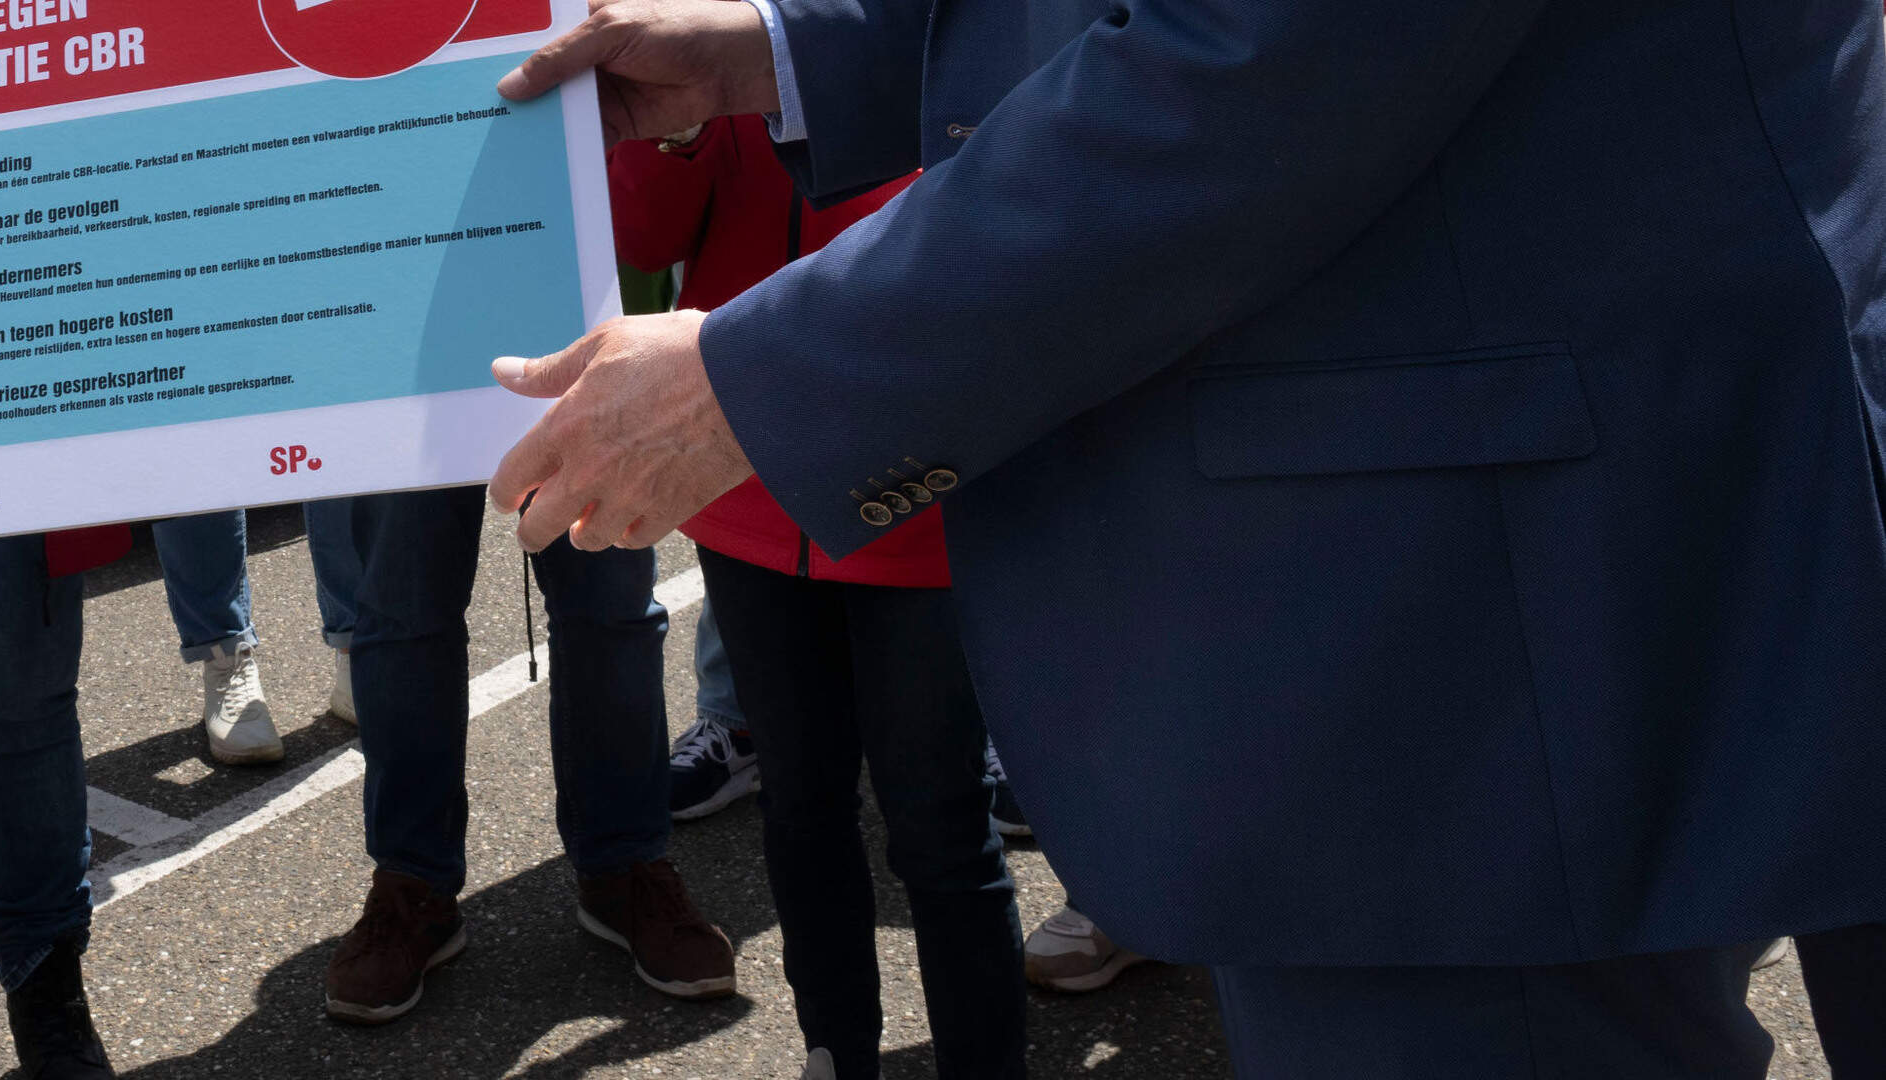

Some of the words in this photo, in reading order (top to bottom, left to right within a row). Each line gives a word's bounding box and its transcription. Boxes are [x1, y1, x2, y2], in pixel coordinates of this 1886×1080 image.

[63, 26, 146, 76] CBR
[10, 175, 29, 188] één
[30, 169, 71, 185] centrale
[72, 160, 133, 179] CBR-locatie.
[134, 151, 179, 169] Parkstad
[180, 151, 194, 163] en
[195, 141, 250, 160] Maastricht
[250, 137, 290, 152] moeten
[290, 134, 311, 146] een
[311, 124, 376, 143] volwaardige
[377, 112, 454, 135] praktijkfunctie
[455, 105, 511, 122] behouden.
[5, 223, 83, 245] bereikbaarheid,
[83, 213, 152, 233] verkeersdruk,
[153, 209, 191, 224] kosten,
[192, 200, 241, 218] regionale
[242, 194, 291, 211] spreiding
[292, 192, 306, 204] en
[307, 182, 384, 202] markteffecten.
[23, 207, 44, 225] de
[46, 198, 120, 224] gevolgen
[55, 280, 93, 295] moeten
[94, 277, 114, 289] hun
[115, 268, 182, 287] onderneming
[183, 266, 197, 278] op
[198, 263, 219, 275] een
[219, 257, 261, 272] eerlijke
[261, 255, 276, 267] en
[277, 240, 383, 265] toekomstbestendige
[384, 235, 423, 250] manier
[423, 230, 464, 245] kunnen
[464, 225, 503, 239] blijven
[504, 219, 546, 234] voeren.
[8, 322, 55, 342] tegen
[58, 314, 115, 336] hogere
[118, 306, 174, 328] kosten
[33, 340, 84, 356] reistijden,
[85, 336, 113, 350] extra
[114, 332, 148, 346] lessen
[149, 330, 163, 341] en
[164, 325, 201, 339] hogere
[202, 314, 279, 334] examenkosten
[280, 311, 305, 324] door
[305, 301, 377, 321] centralisatie.
[51, 364, 186, 398] gesprekspartner
[58, 397, 107, 413] erkennen
[108, 393, 125, 407] als
[126, 390, 154, 405] vaste
[155, 383, 206, 400] regionale
[206, 374, 295, 395] gesprekspartner.
[270, 445, 308, 476] SP
